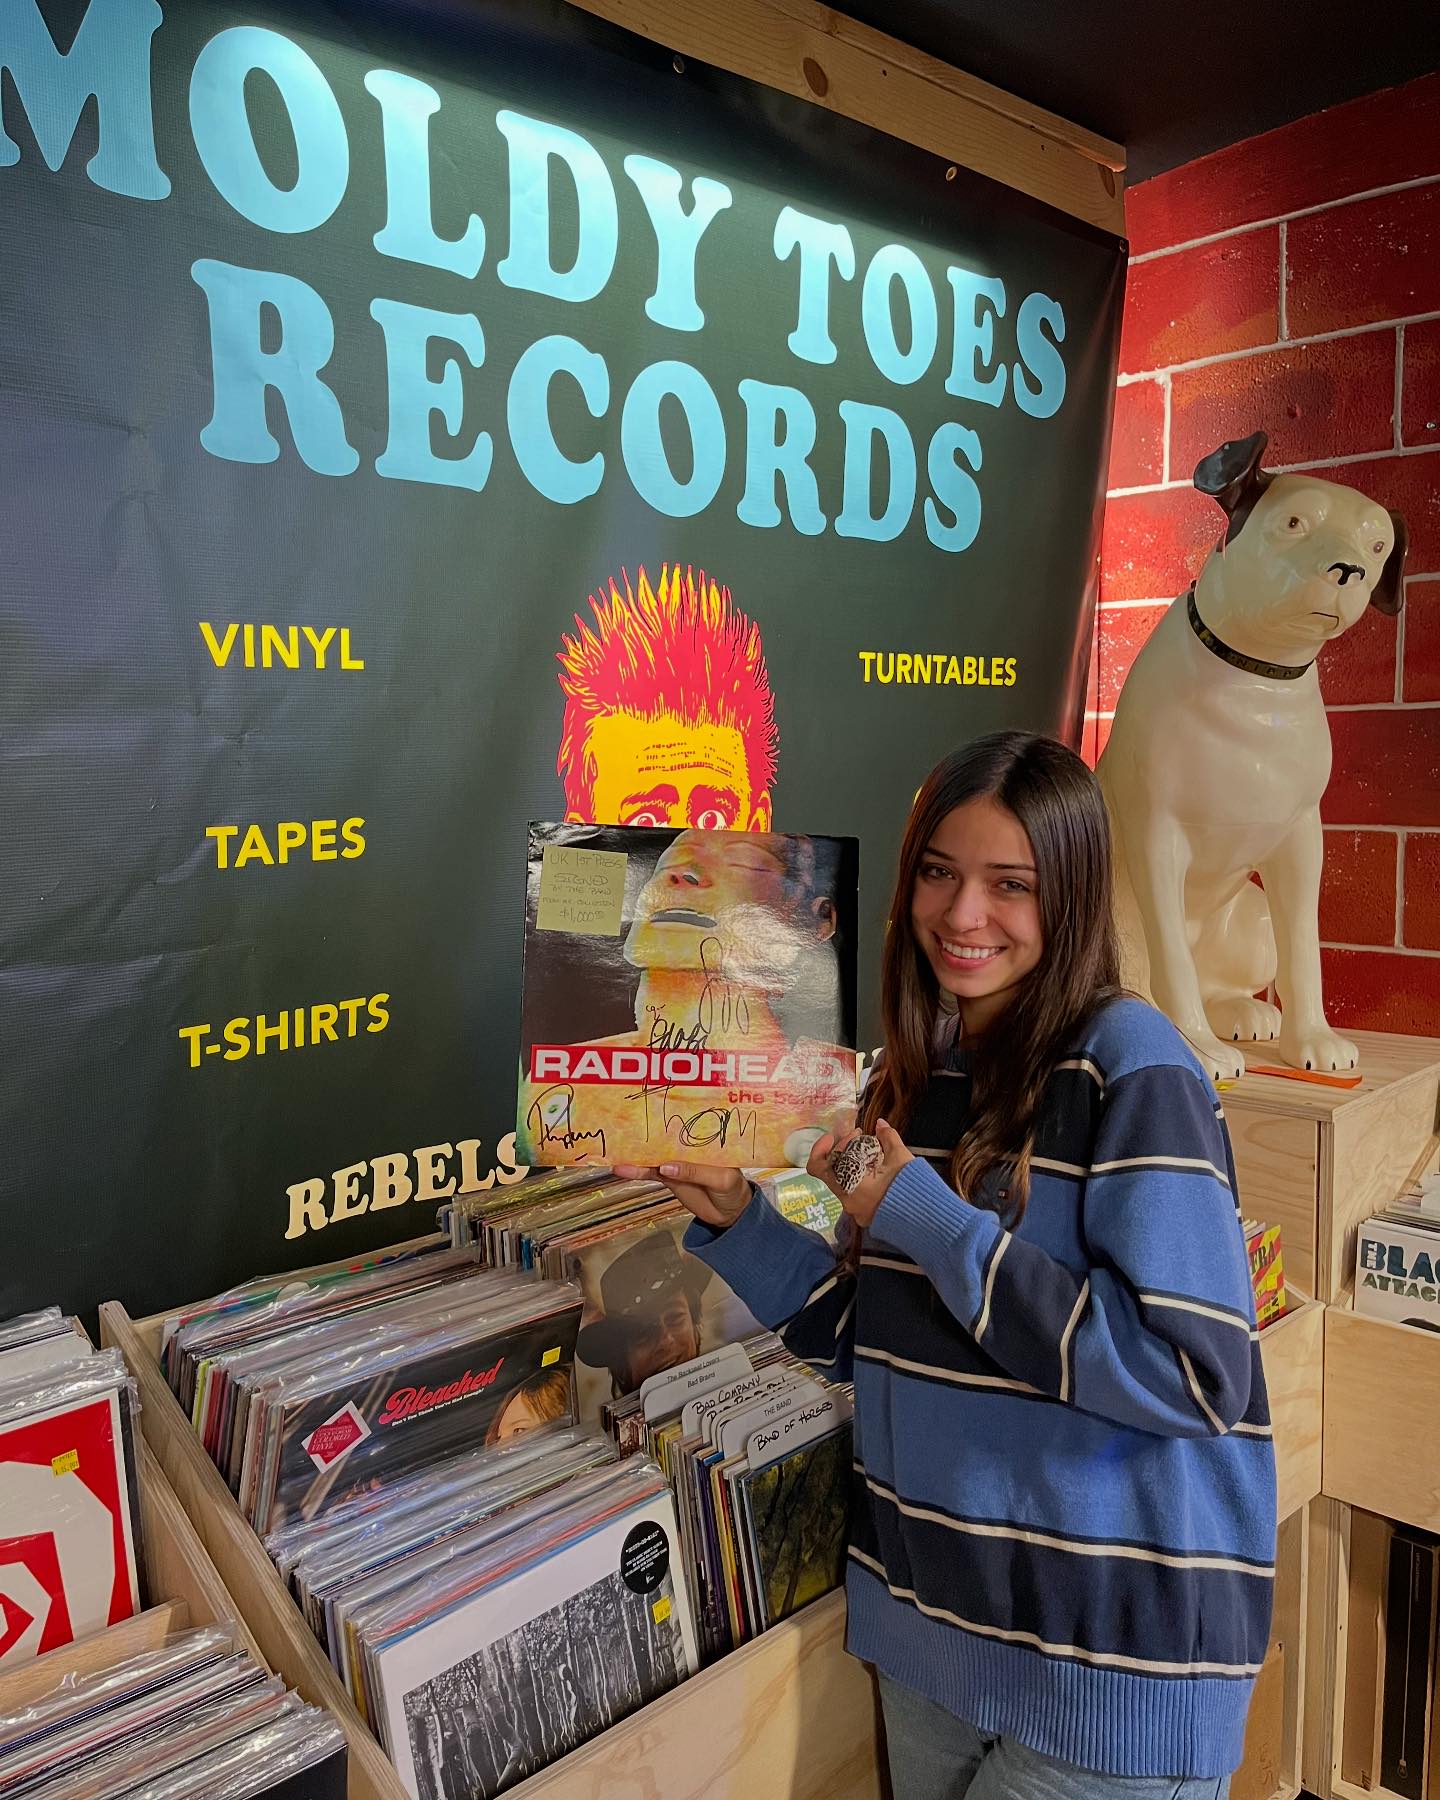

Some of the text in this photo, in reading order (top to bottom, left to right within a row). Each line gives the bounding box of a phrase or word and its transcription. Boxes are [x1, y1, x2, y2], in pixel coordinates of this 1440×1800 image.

[0, 0, 1067, 419] MOLDY TOES
[190, 258, 983, 553] RECORDS
[199, 623, 365, 670] VINYL
[858, 651, 1017, 687] TURNTABLES
[206, 817, 366, 869] TAPES
[550, 852, 569, 865] UK
[553, 873, 609, 886] SIGNED
[179, 992, 390, 1068] T-SHIRTS
[535, 1049, 843, 1084] RADIOHEAD
[728, 1090, 765, 1104] the
[284, 1131, 530, 1240] REBELS
[805, 1202, 825, 1220] Pet
[1360, 1238, 1440, 1285] BLA
[1362, 1272, 1440, 1304] ATTAC
[378, 1356, 505, 1425] Bleached
[667, 1374, 678, 1383] The
[687, 1378, 699, 1388] Bad
[691, 1399, 716, 1415] BAD
[717, 1374, 761, 1404] COMPANY
[753, 1400, 834, 1451] BAND OF HORSES
[763, 1398, 792, 1417] THE BAND
